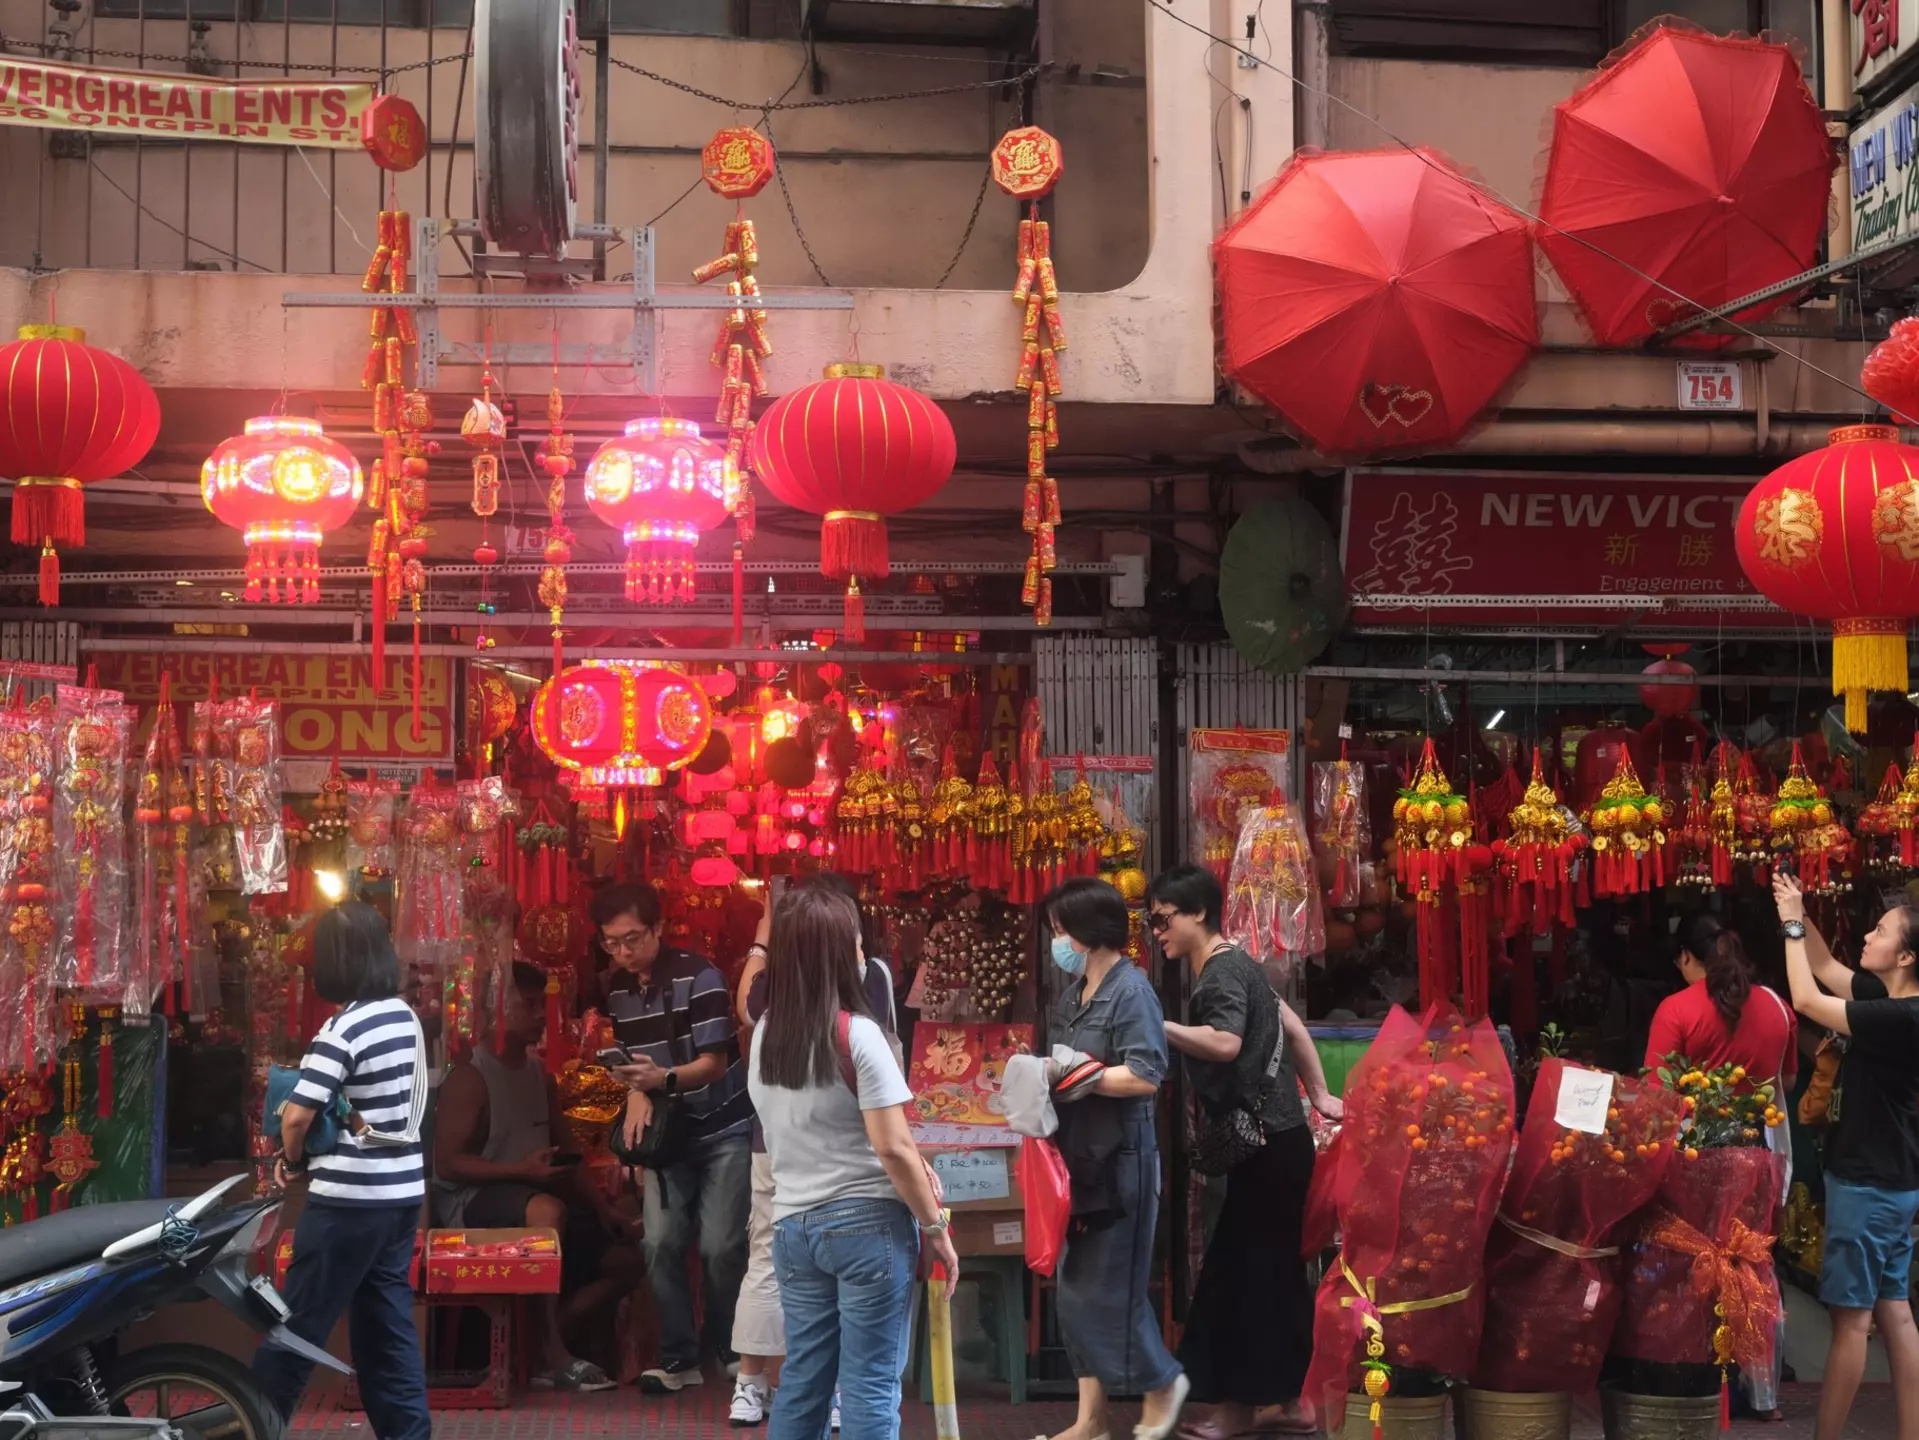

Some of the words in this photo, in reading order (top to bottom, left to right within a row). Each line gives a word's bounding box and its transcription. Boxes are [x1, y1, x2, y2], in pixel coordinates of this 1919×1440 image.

[67, 111, 268, 137] ONGPIN
[235, 86, 358, 129] ENTS.
[1852, 126, 1886, 199] NEW
[1855, 186, 1902, 250] Trading
[1687, 375, 1733, 400] 754
[1479, 492, 1614, 527] NEW
[1604, 532, 1641, 566] 新
[1677, 533, 1714, 567] 勝
[1600, 575, 1724, 593] Engagement
[923, 1028, 972, 1077] 福
[936, 1159, 945, 1170] 3
